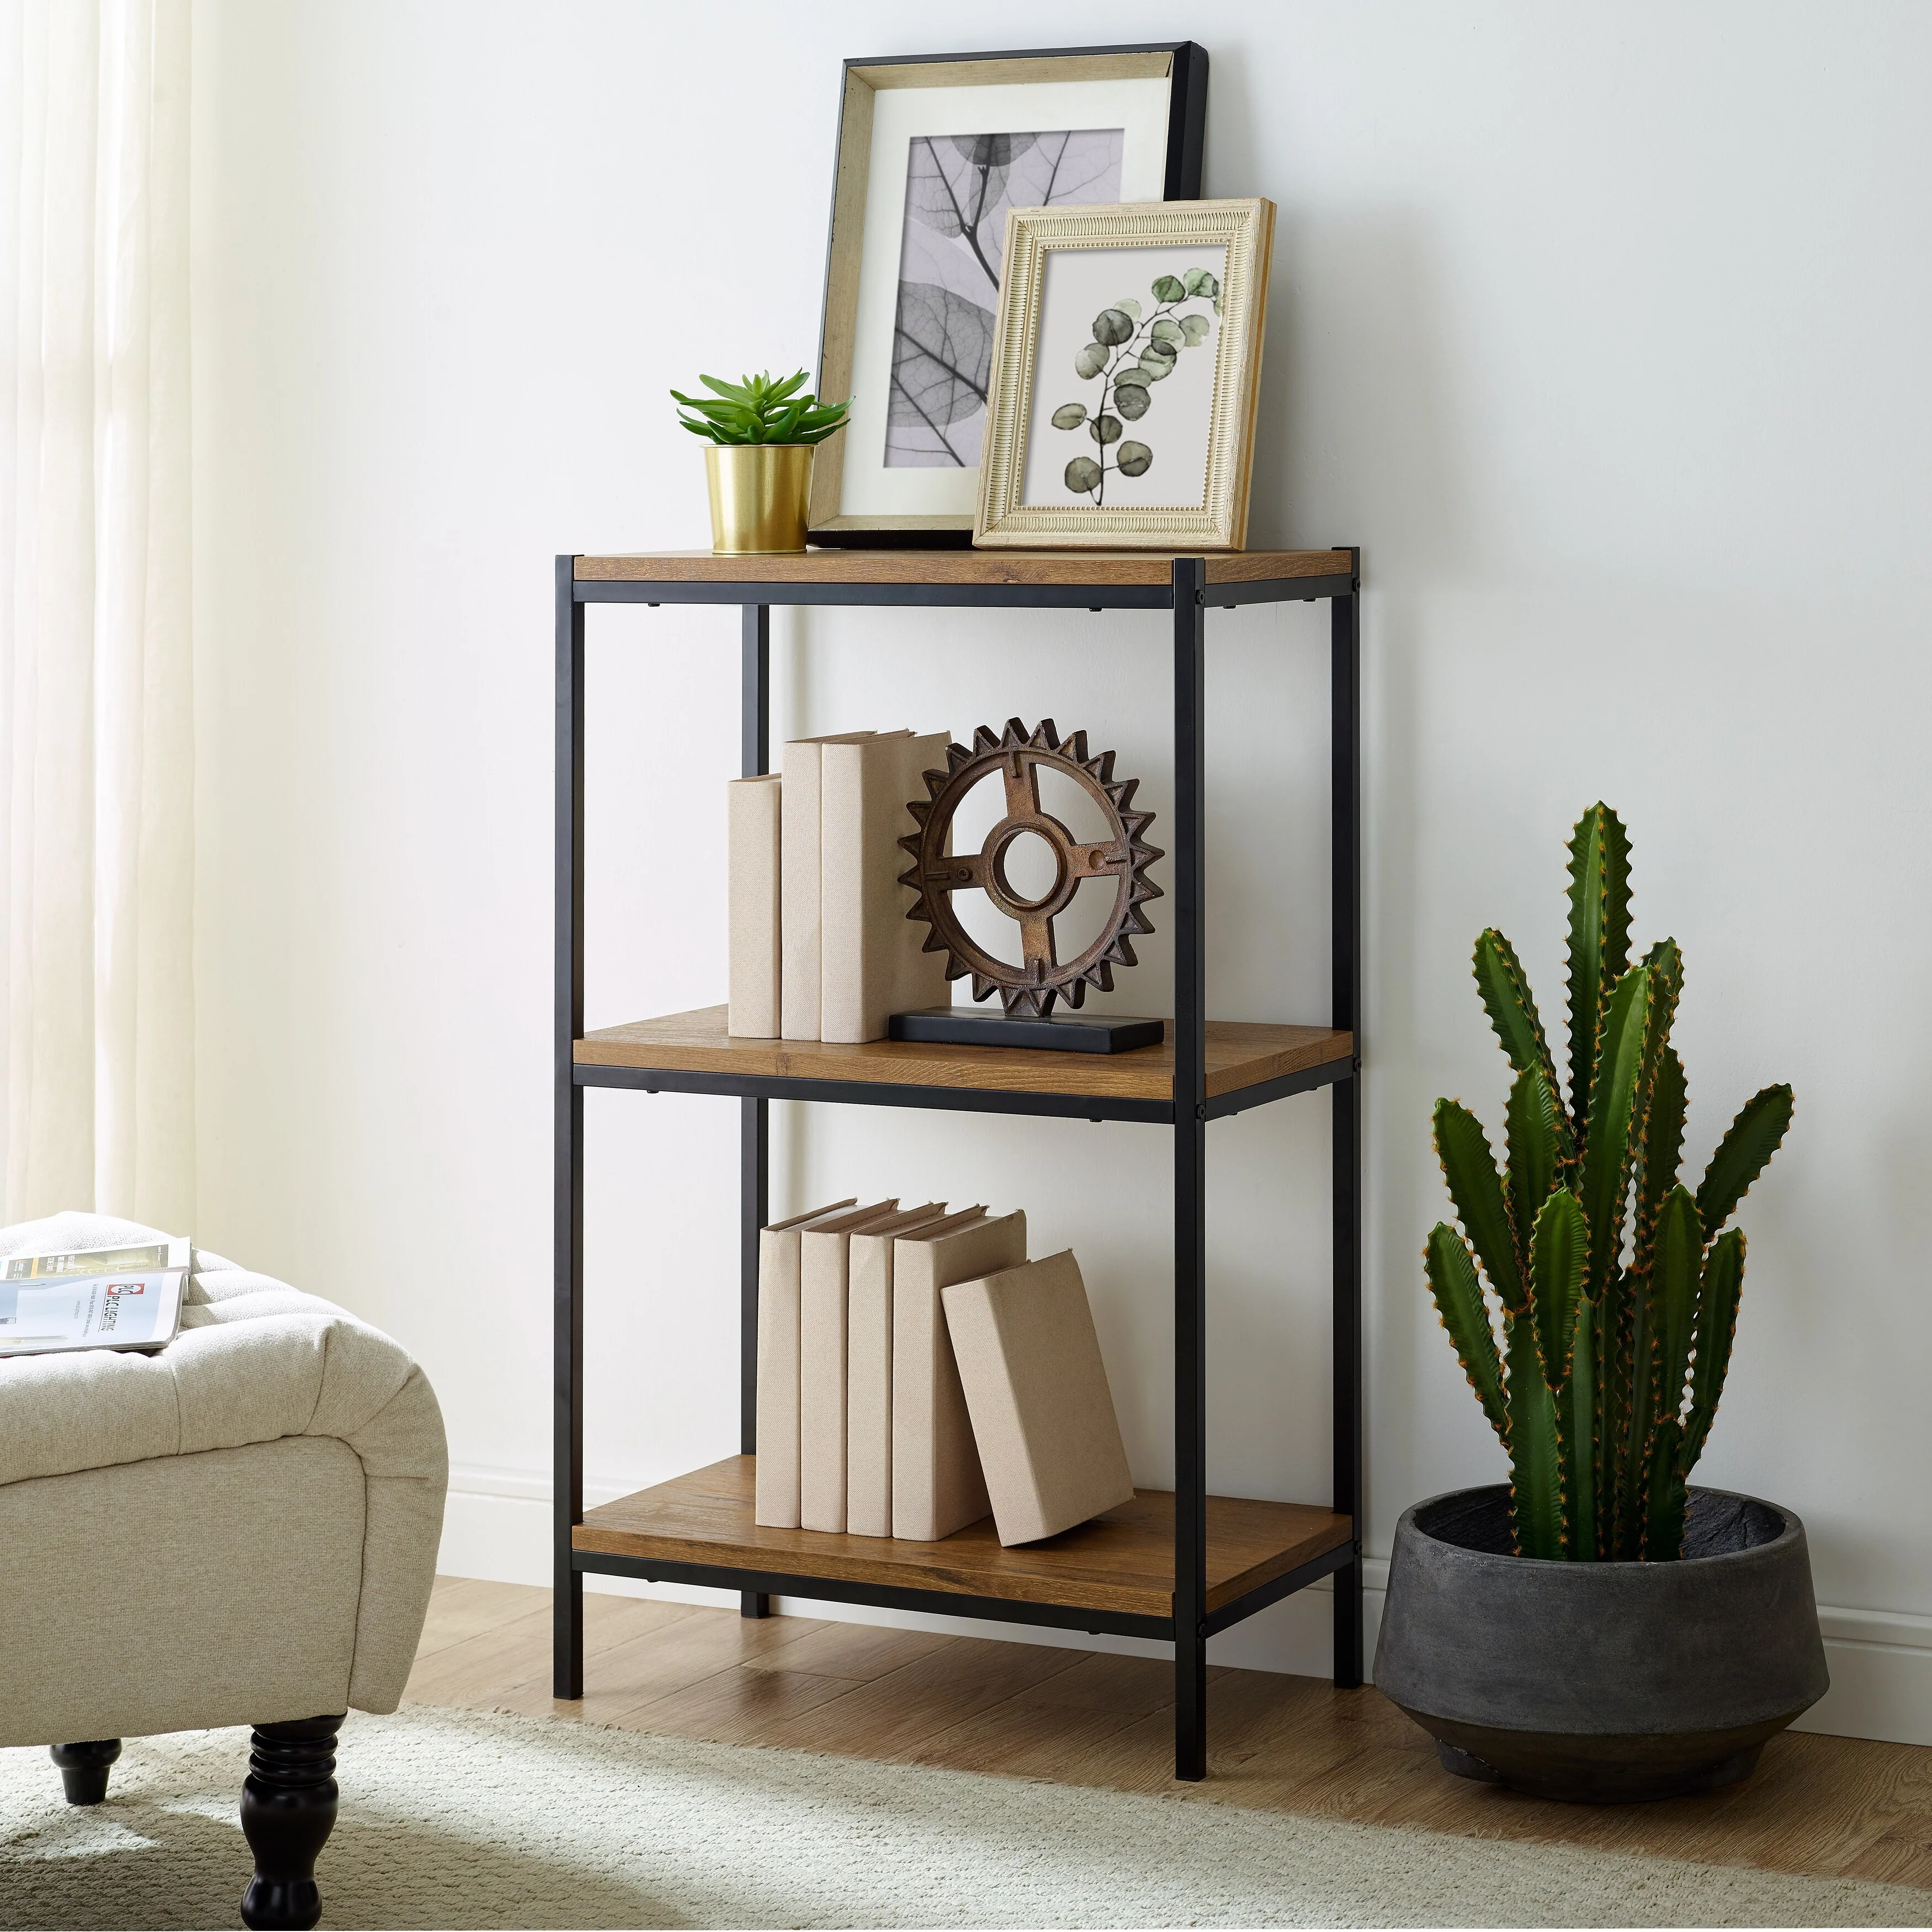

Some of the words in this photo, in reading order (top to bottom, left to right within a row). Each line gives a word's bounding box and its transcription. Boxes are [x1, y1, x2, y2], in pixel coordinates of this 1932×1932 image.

[118, 1285, 134, 1293] PLC
[105, 1296, 120, 1306] PLC
[100, 1307, 119, 1331] LIGHTING
